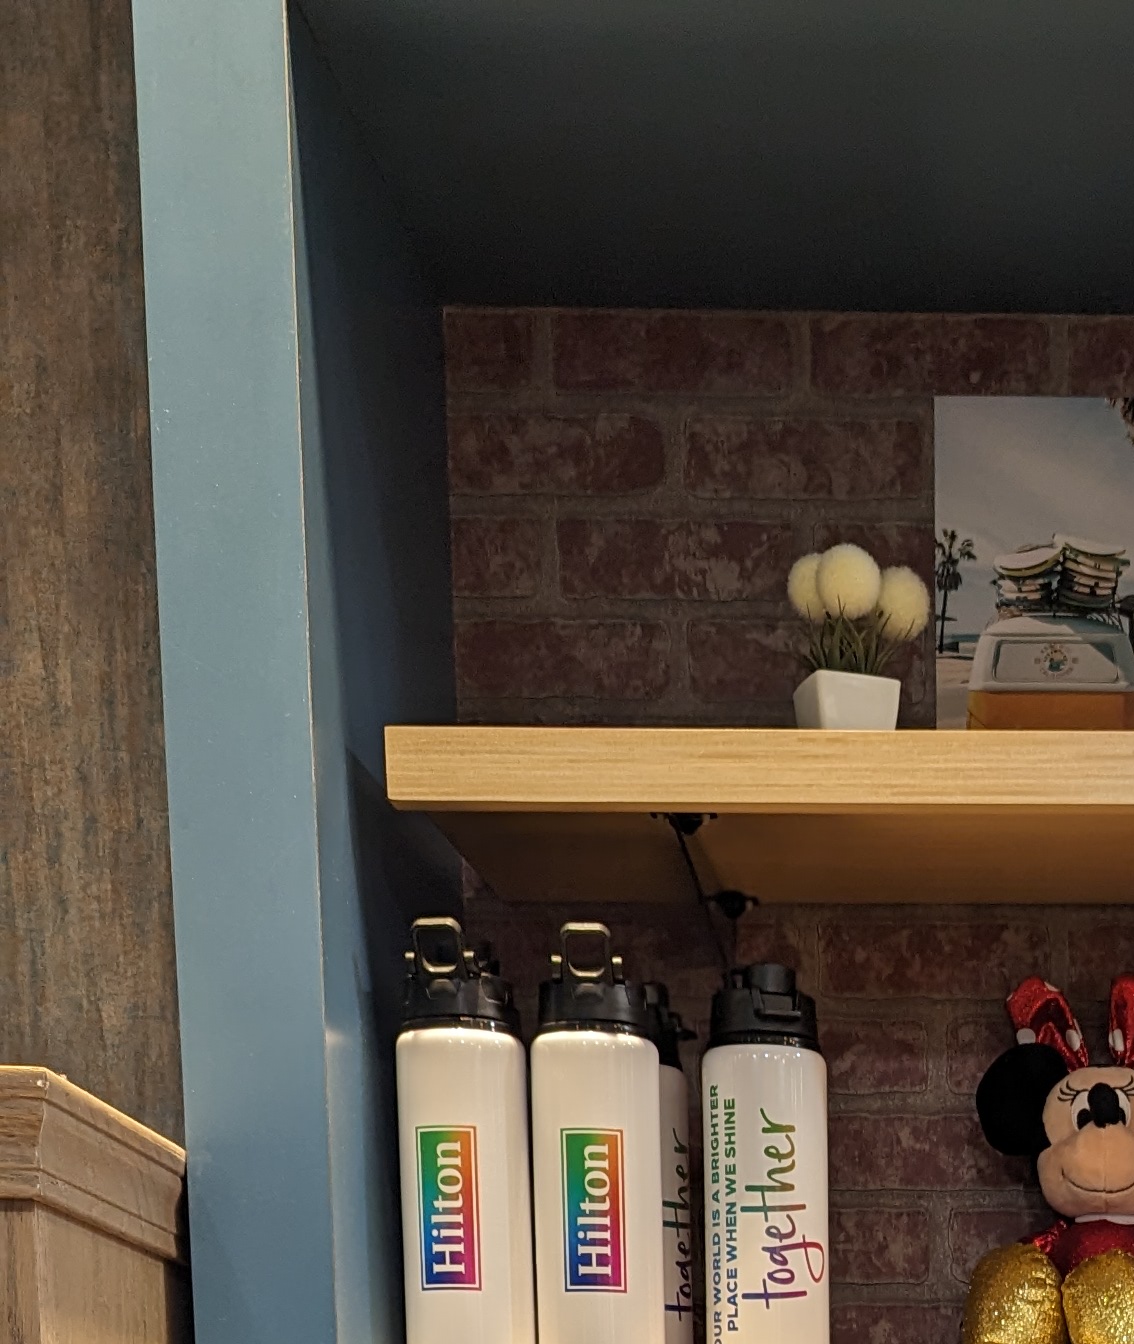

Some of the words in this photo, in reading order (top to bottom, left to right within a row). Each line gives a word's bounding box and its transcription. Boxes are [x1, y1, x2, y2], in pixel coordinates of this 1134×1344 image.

[709, 1084, 720, 1184] BRIGHTER
[723, 1098, 736, 1158] SHINE
[431, 1140, 465, 1275] Hilton
[577, 1143, 612, 1277] Hilton
[711, 1189, 720, 1204] A
[725, 1163, 737, 1197] WE
[740, 1107, 825, 1309] together
[712, 1208, 721, 1227] IS
[725, 1201, 738, 1263] WHEN
[712, 1232, 722, 1305] WORLD
[726, 1267, 739, 1332] PLACE
